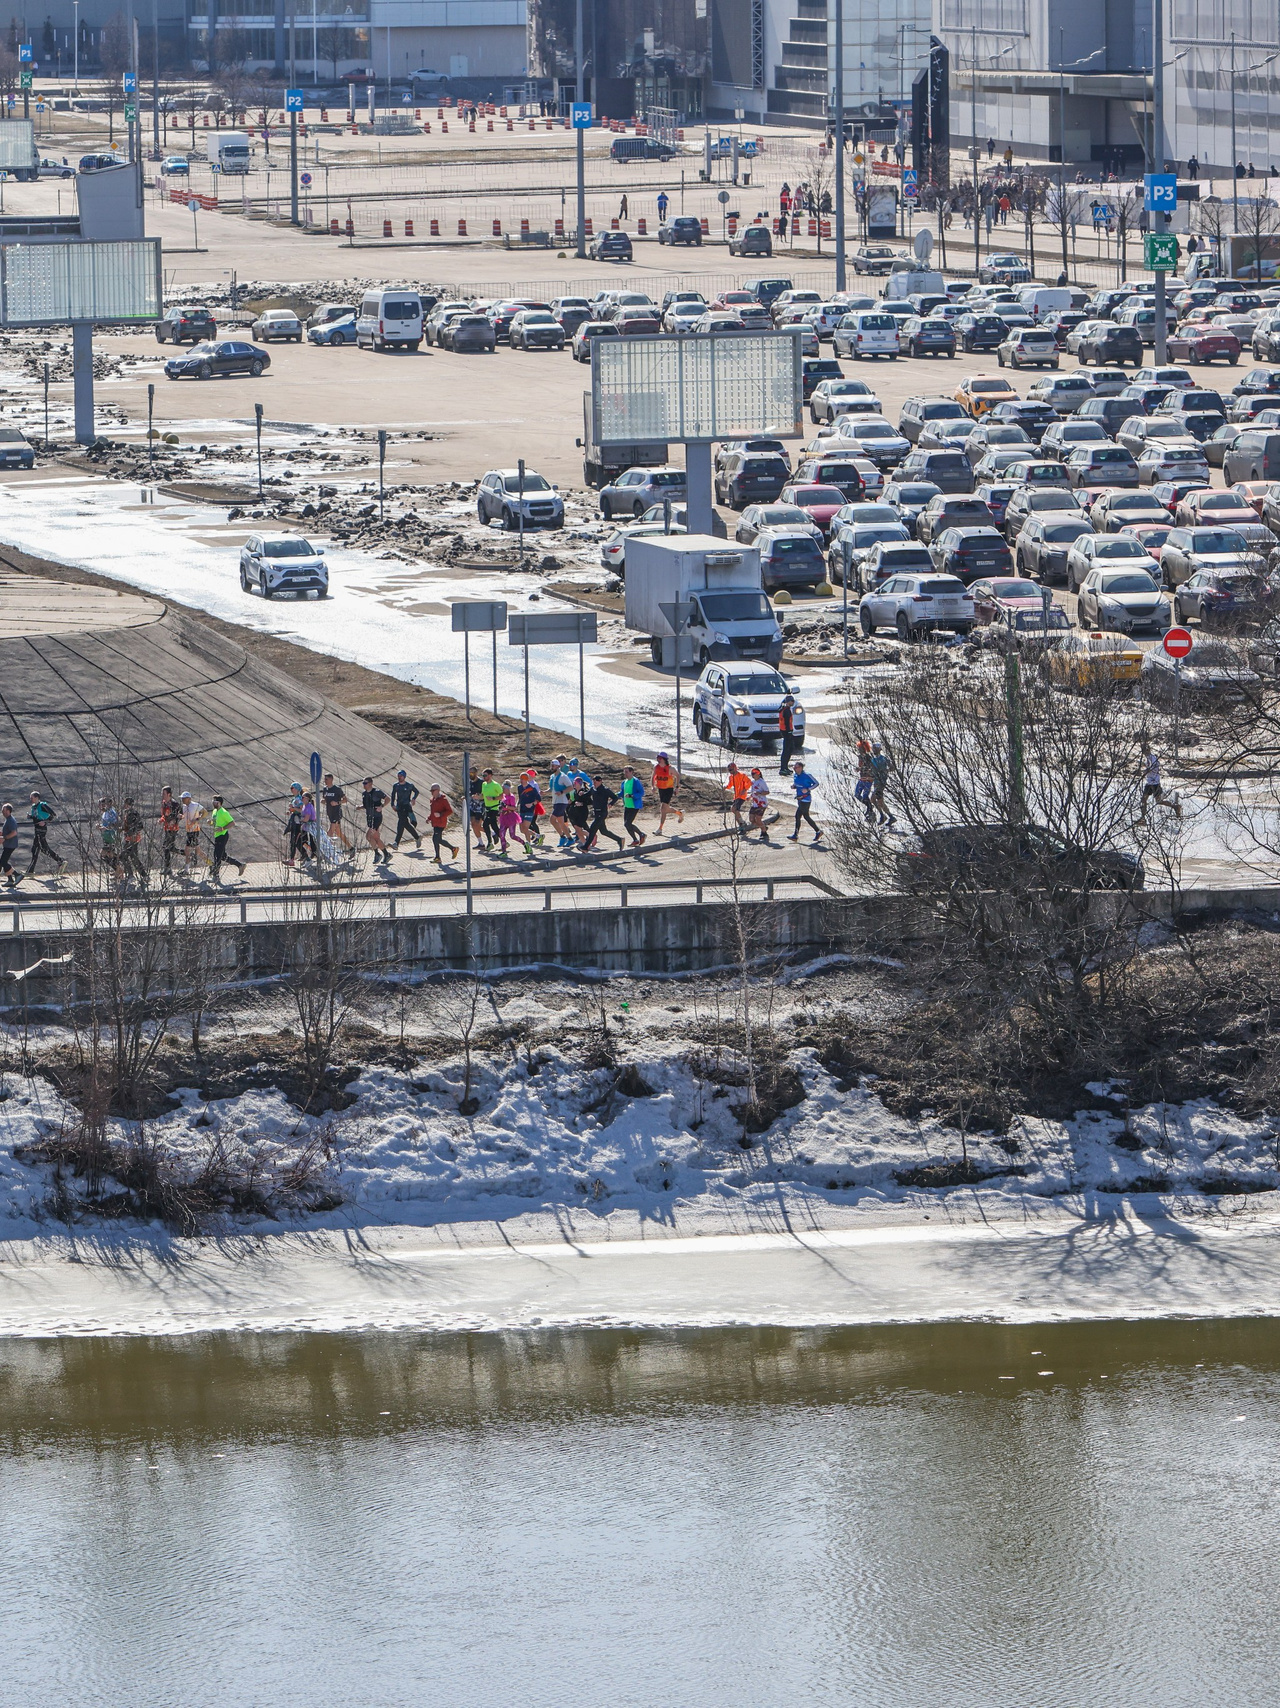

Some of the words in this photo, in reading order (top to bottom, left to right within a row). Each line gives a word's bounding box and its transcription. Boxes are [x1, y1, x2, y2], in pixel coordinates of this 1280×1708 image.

[125, 78, 136, 87] P2
[288, 96, 302, 106] P2
[574, 110, 590, 122] P3
[1153, 185, 1174, 201] P3
